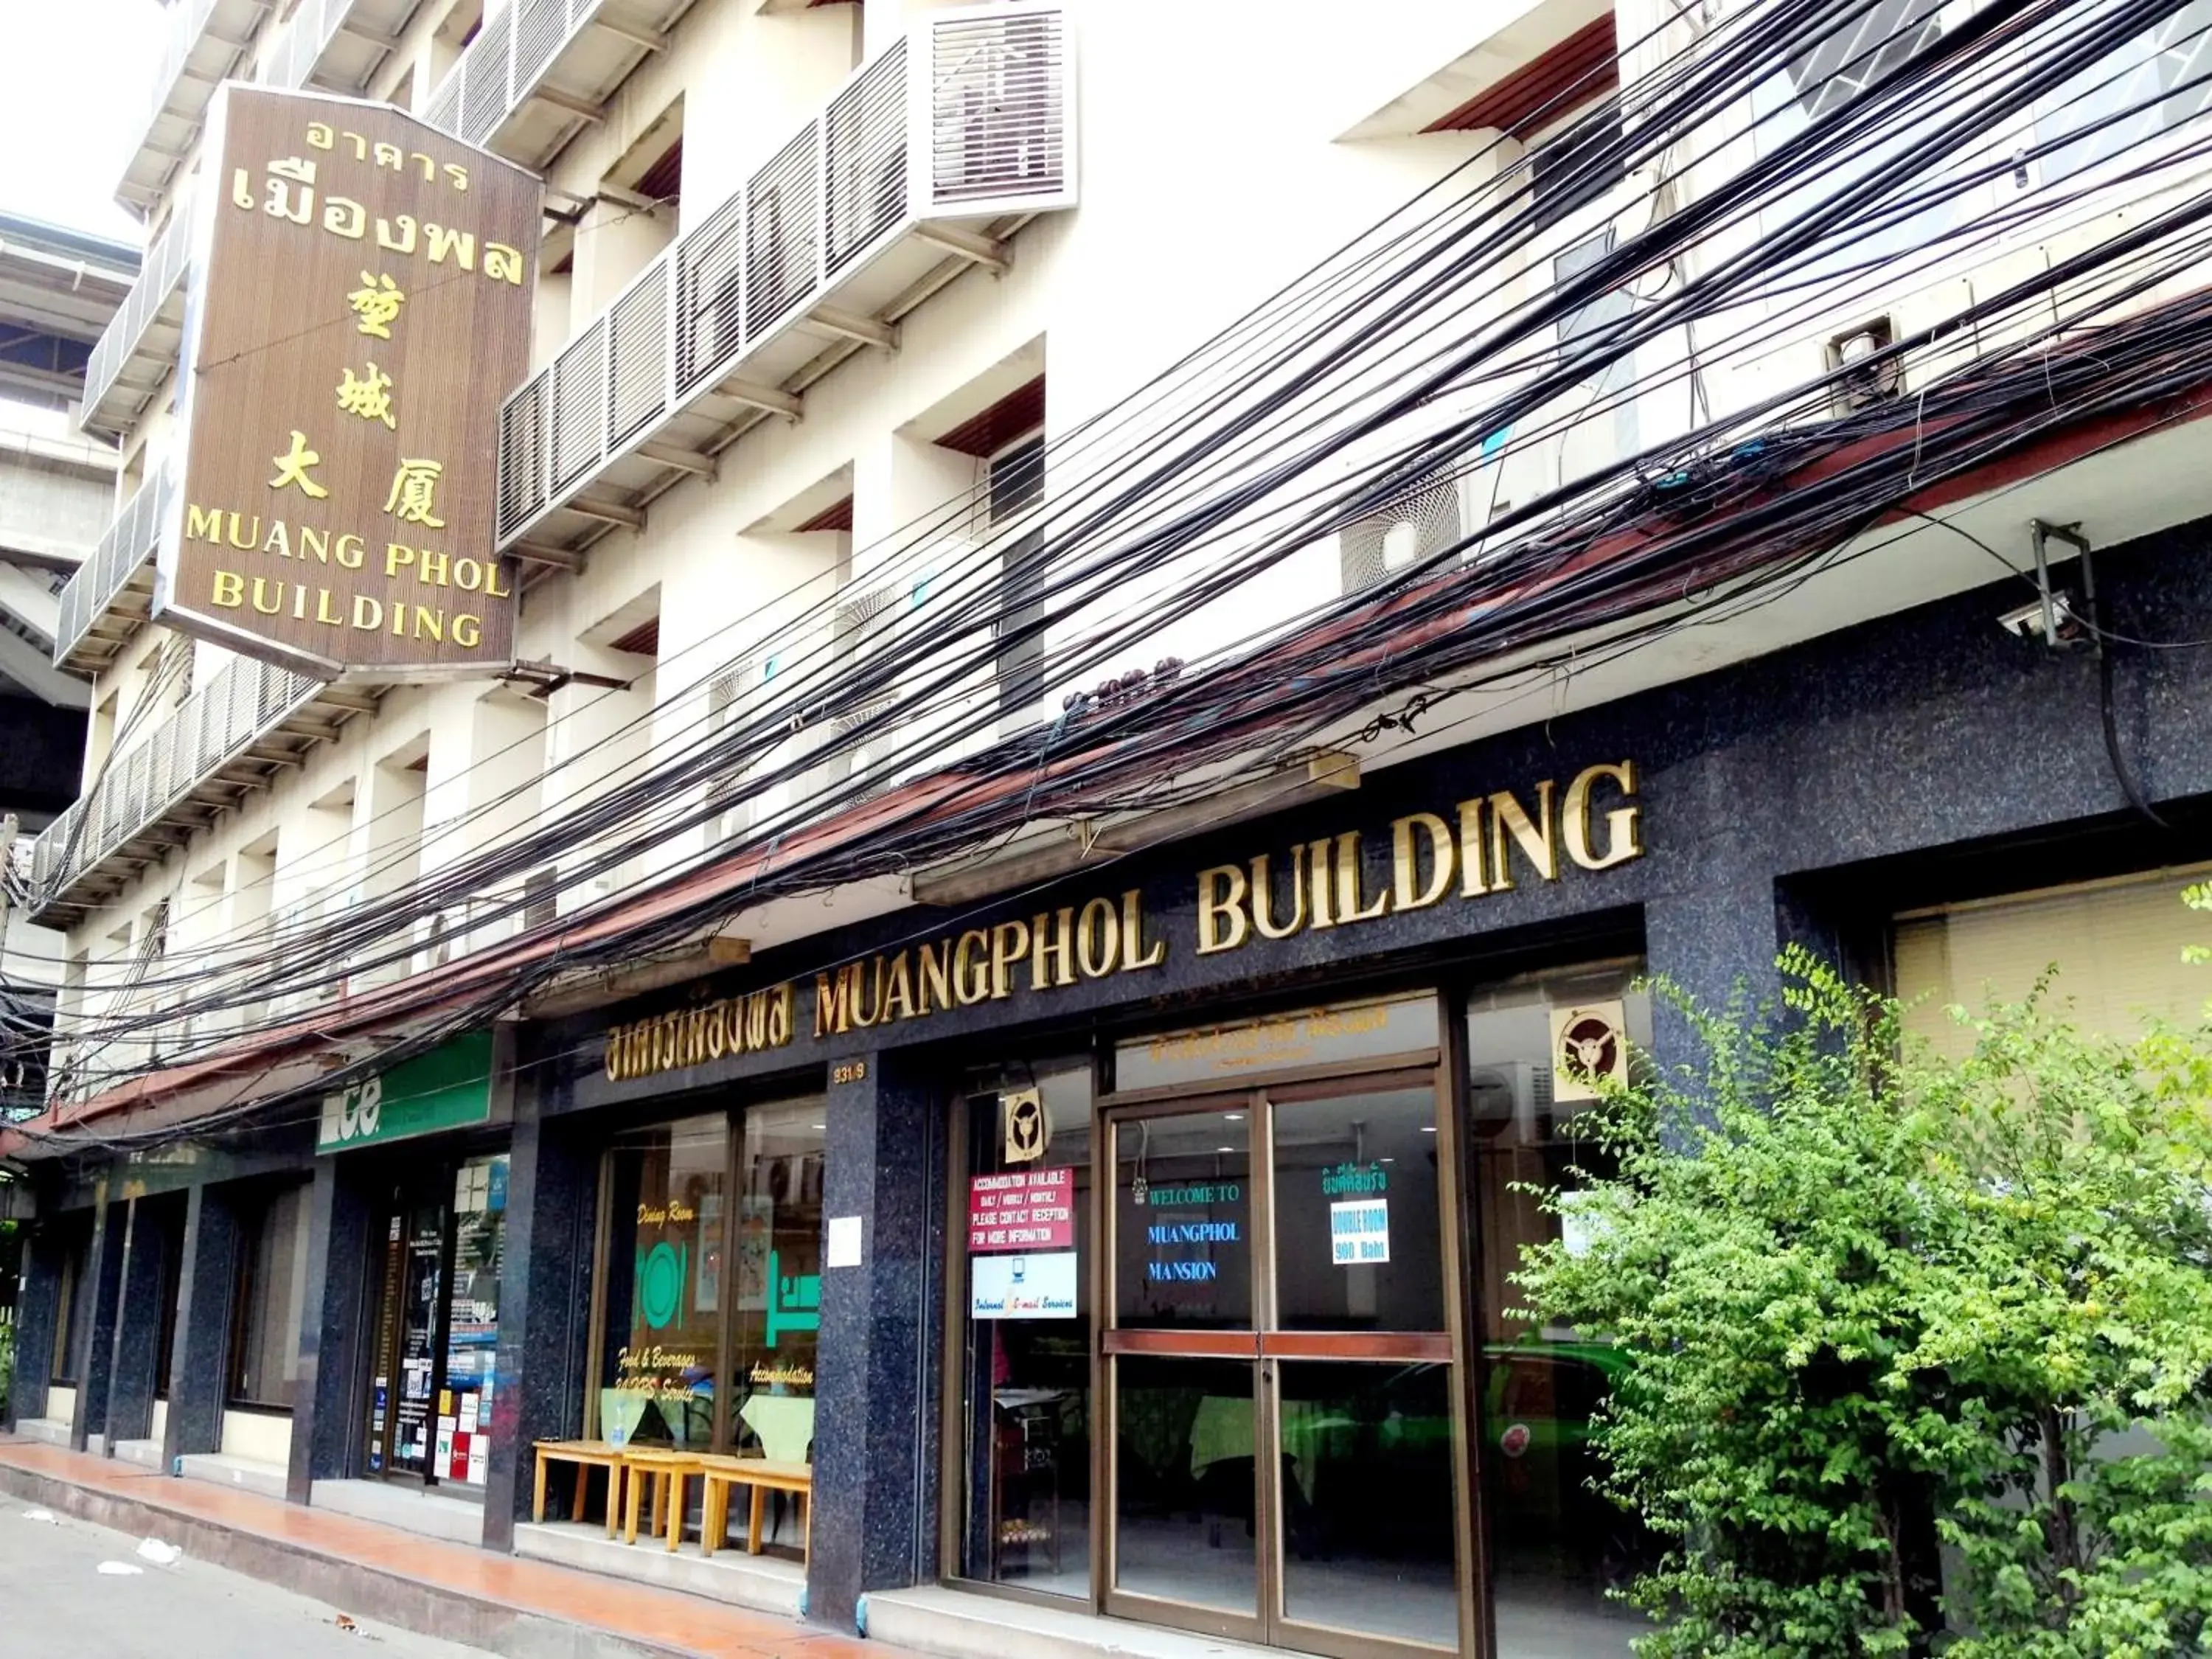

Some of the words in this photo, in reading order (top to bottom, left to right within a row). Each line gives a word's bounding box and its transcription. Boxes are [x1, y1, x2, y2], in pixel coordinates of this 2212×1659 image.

[305, 120, 469, 191] อาคาร
[232, 156, 523, 285] เมืองพล
[186, 504, 365, 569] MUANG
[384, 543, 510, 599] PHOL
[211, 570, 481, 649] BUILDING
[815, 888, 1164, 1037] MUANGPHOL
[1196, 759, 1644, 955] BUILDING
[1150, 1186, 1214, 1206] WELCOME
[1218, 1185, 1239, 1201] TO
[637, 1203, 665, 1230] Dining
[668, 1200, 693, 1221] Room
[973, 1211, 997, 1225] PLEASE
[999, 1209, 1029, 1224] CONTACT
[973, 1232, 985, 1245] FOR
[988, 1230, 1006, 1244] MORE
[1148, 1222, 1239, 1244] MUANGPHOL
[1148, 1262, 1216, 1281] MANSION
[619, 1347, 640, 1372] Food
